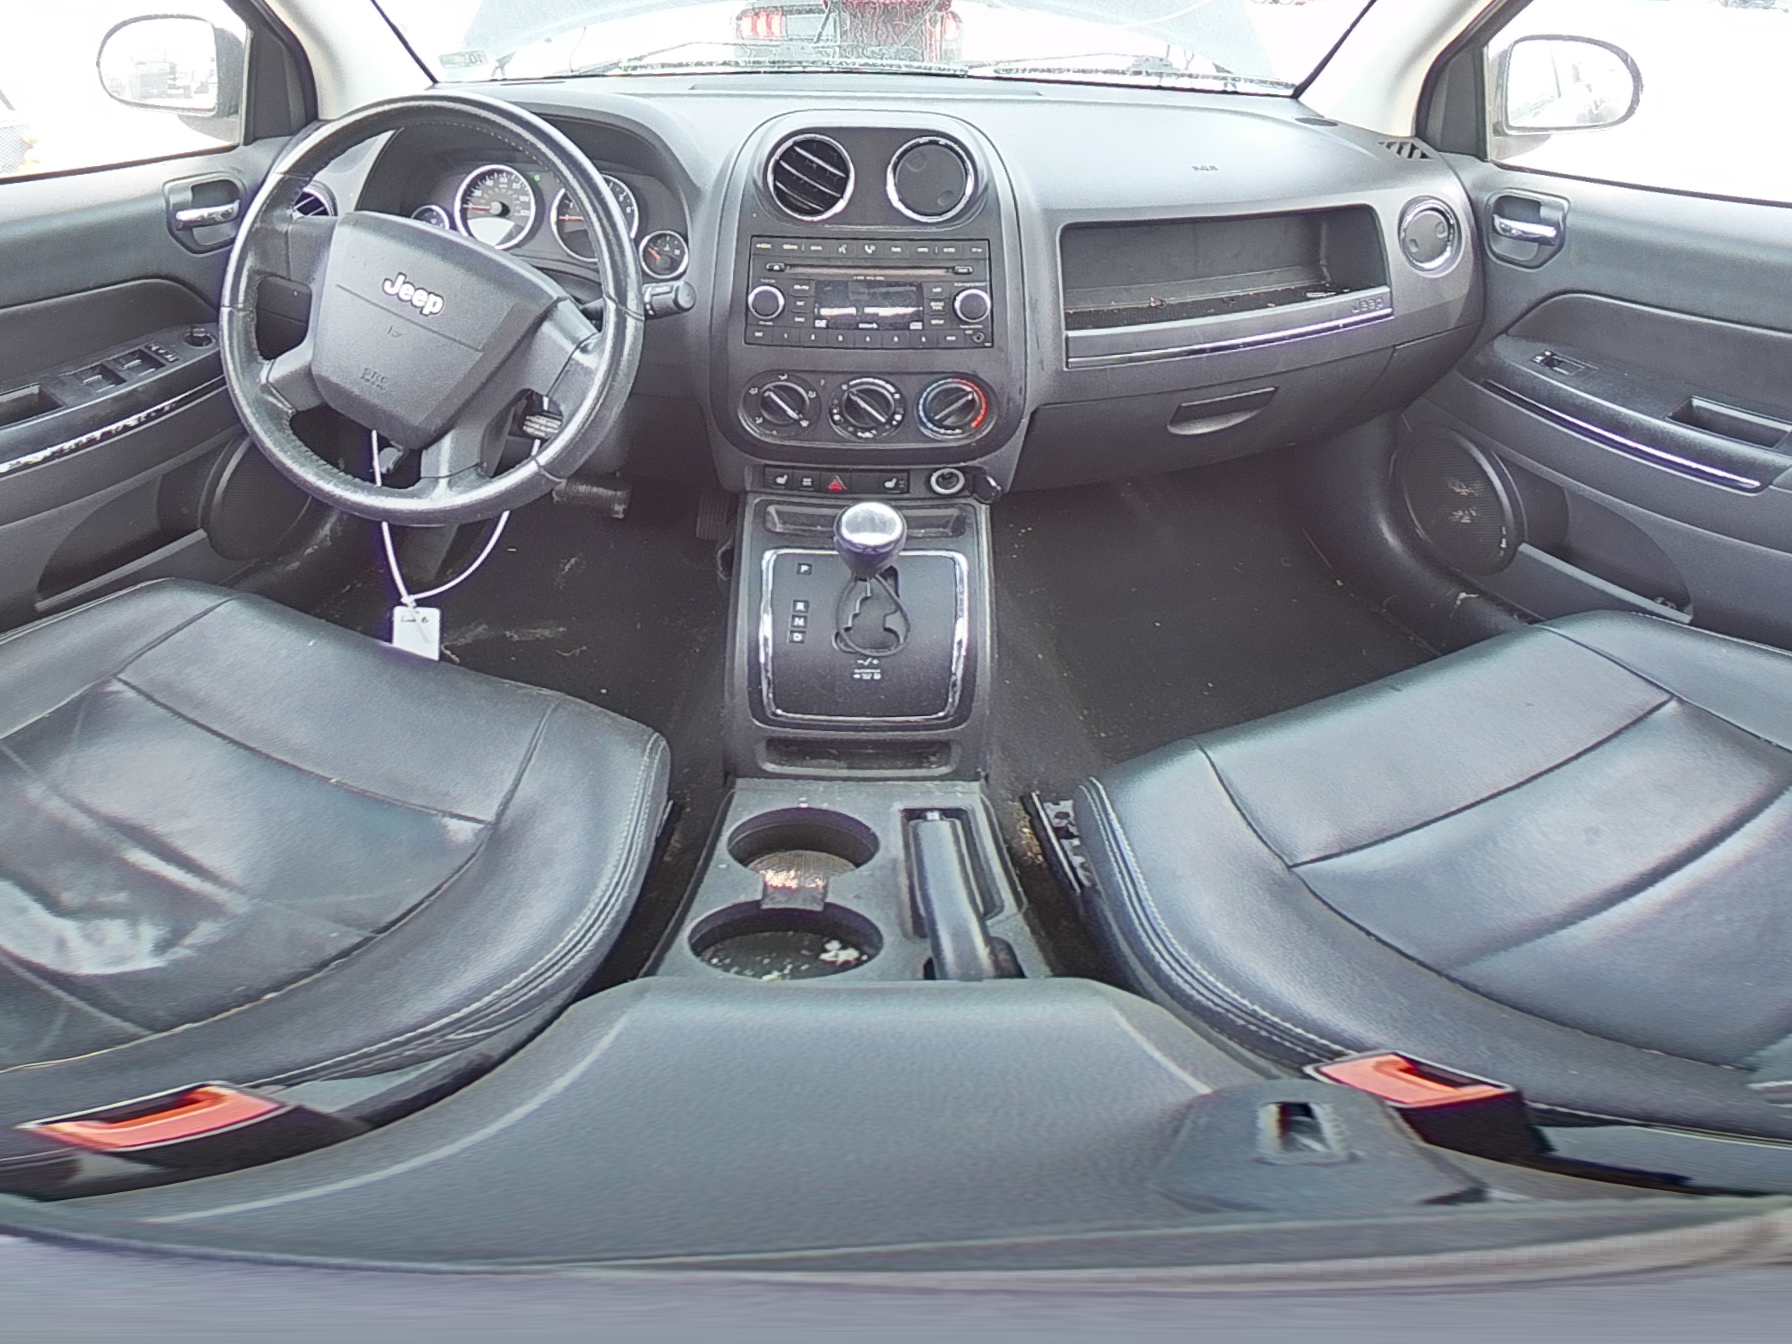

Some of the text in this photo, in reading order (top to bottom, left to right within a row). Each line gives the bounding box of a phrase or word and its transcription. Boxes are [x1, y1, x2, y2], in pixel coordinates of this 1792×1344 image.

[382, 272, 444, 317] Jeep
[1351, 297, 1384, 314] Jeep
[800, 565, 809, 573] P
